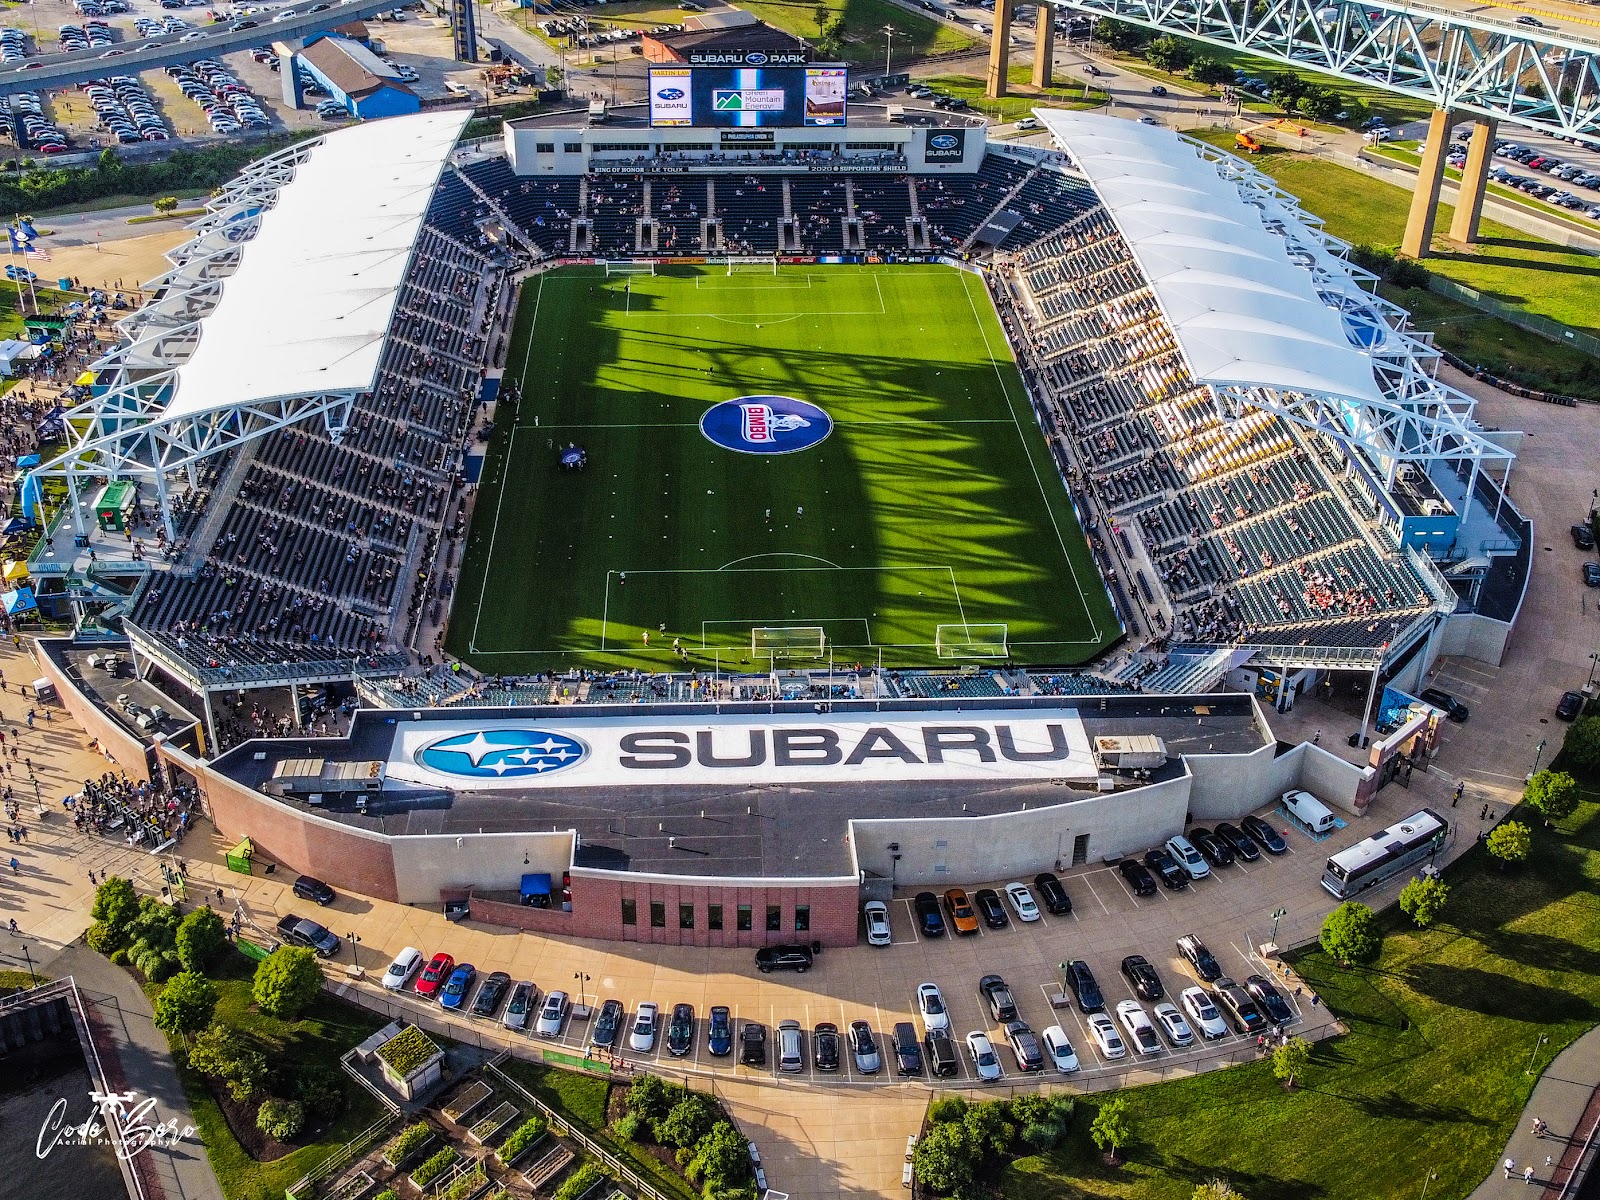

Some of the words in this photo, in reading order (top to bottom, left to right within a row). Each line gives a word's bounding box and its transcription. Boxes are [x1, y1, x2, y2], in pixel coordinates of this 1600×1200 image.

[690, 54, 743, 63] SUBARU
[771, 54, 806, 63] PARK
[747, 407, 767, 440] BIMBO
[619, 724, 1070, 769] SUBARU
